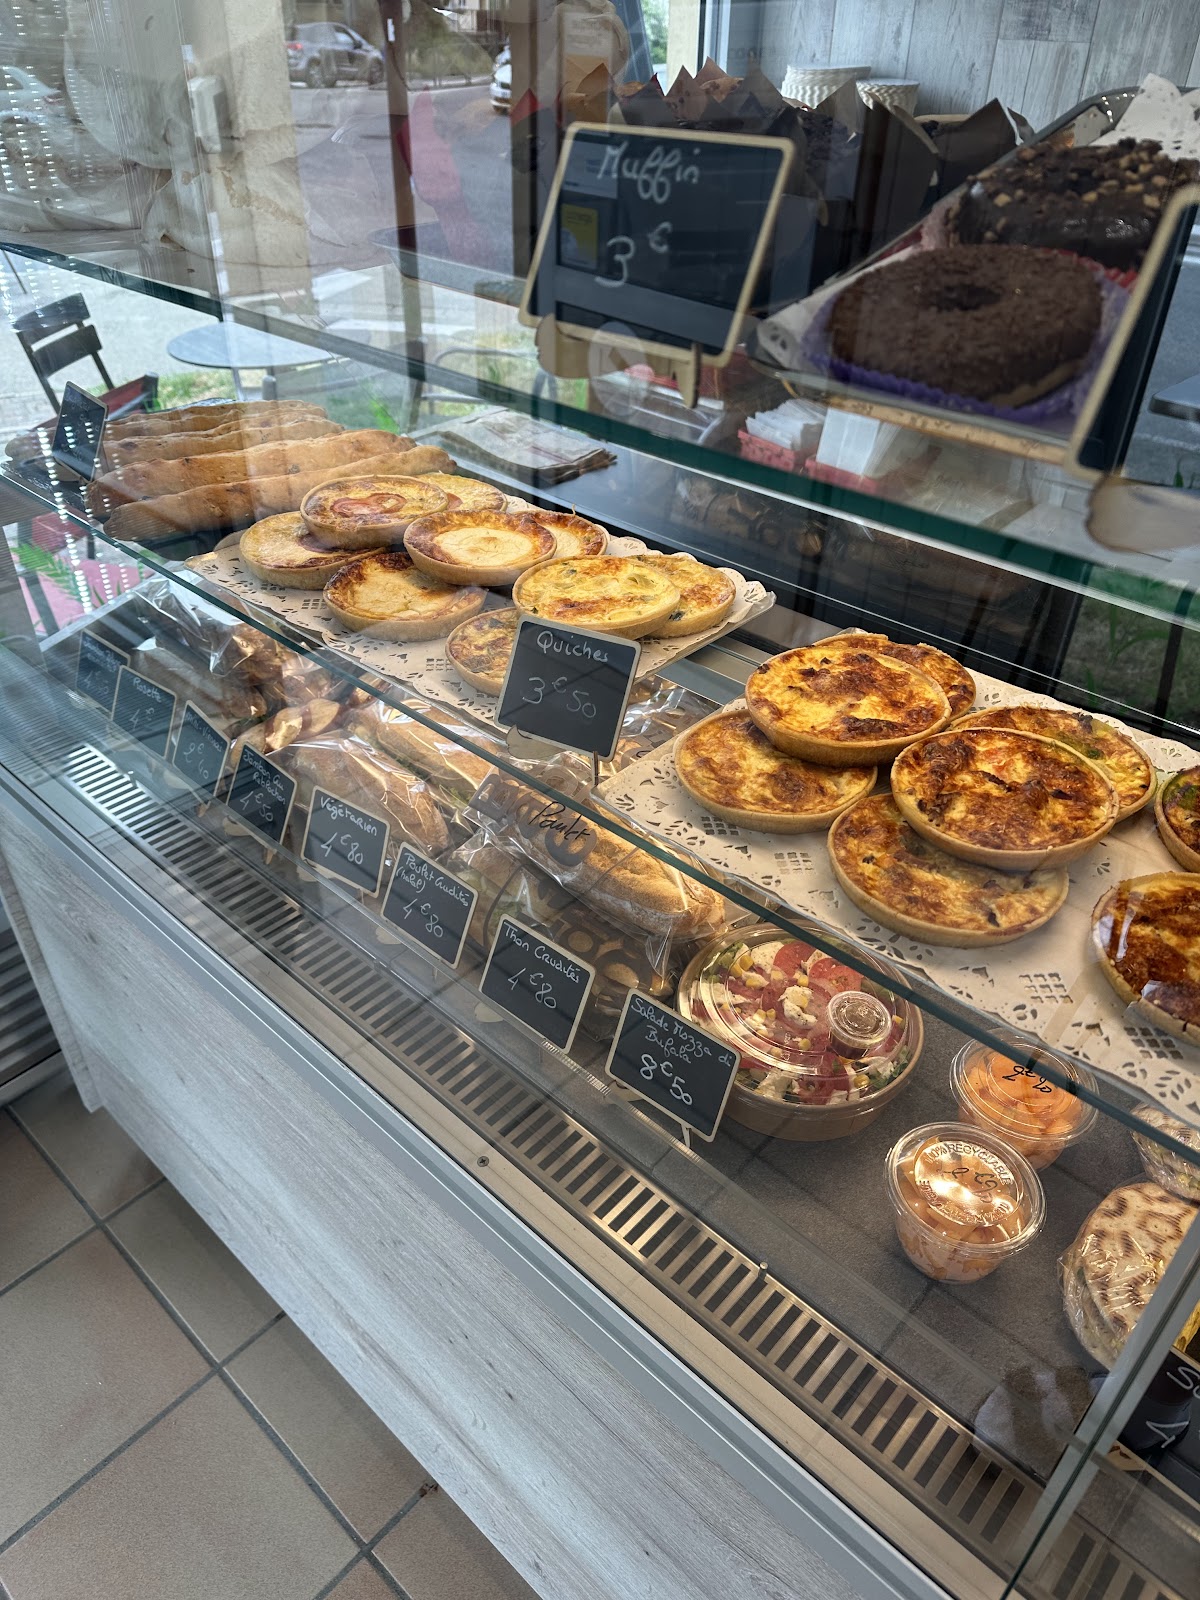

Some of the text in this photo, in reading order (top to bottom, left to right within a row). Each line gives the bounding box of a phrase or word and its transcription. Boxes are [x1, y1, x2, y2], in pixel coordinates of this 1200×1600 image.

[597, 141, 701, 204] Muffin
[536, 630, 609, 664] Quiches
[133, 677, 162, 703] Rosette
[242, 748, 271, 780] Jambon
[395, 868, 426, 895] (halal)
[404, 852, 470, 907] Poulet Crudités
[503, 922, 530, 953] Thon
[534, 944, 580, 984] Crudités
[630, 998, 670, 1032] Salade
[672, 1021, 712, 1058] Mozza
[644, 1025, 692, 1064] Bufala
